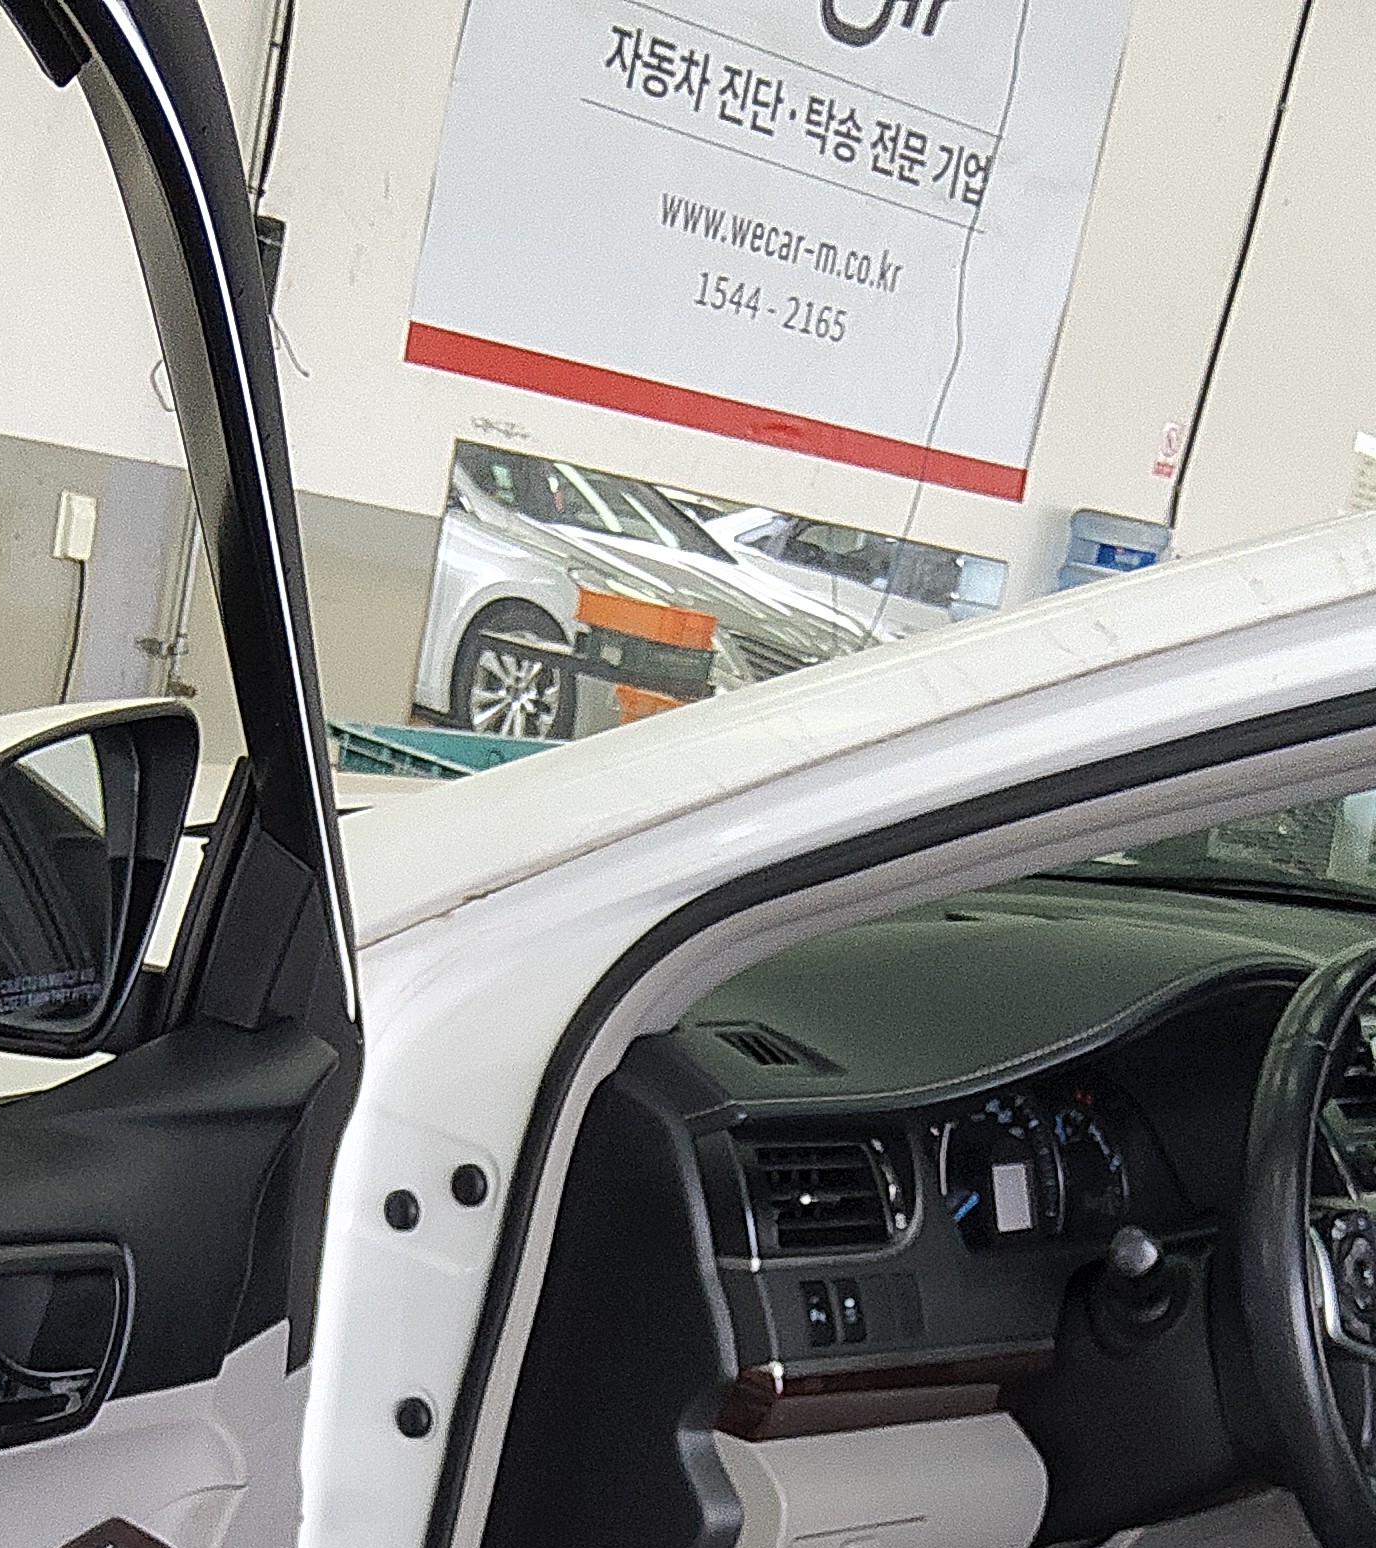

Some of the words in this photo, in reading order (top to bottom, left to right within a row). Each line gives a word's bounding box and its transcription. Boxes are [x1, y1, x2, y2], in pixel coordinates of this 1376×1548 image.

[606, 25, 710, 112] 자동차
[871, 119, 928, 186] 전문
[932, 144, 992, 208] 기업
[661, 192, 904, 293] www.wecar-m.co.kr
